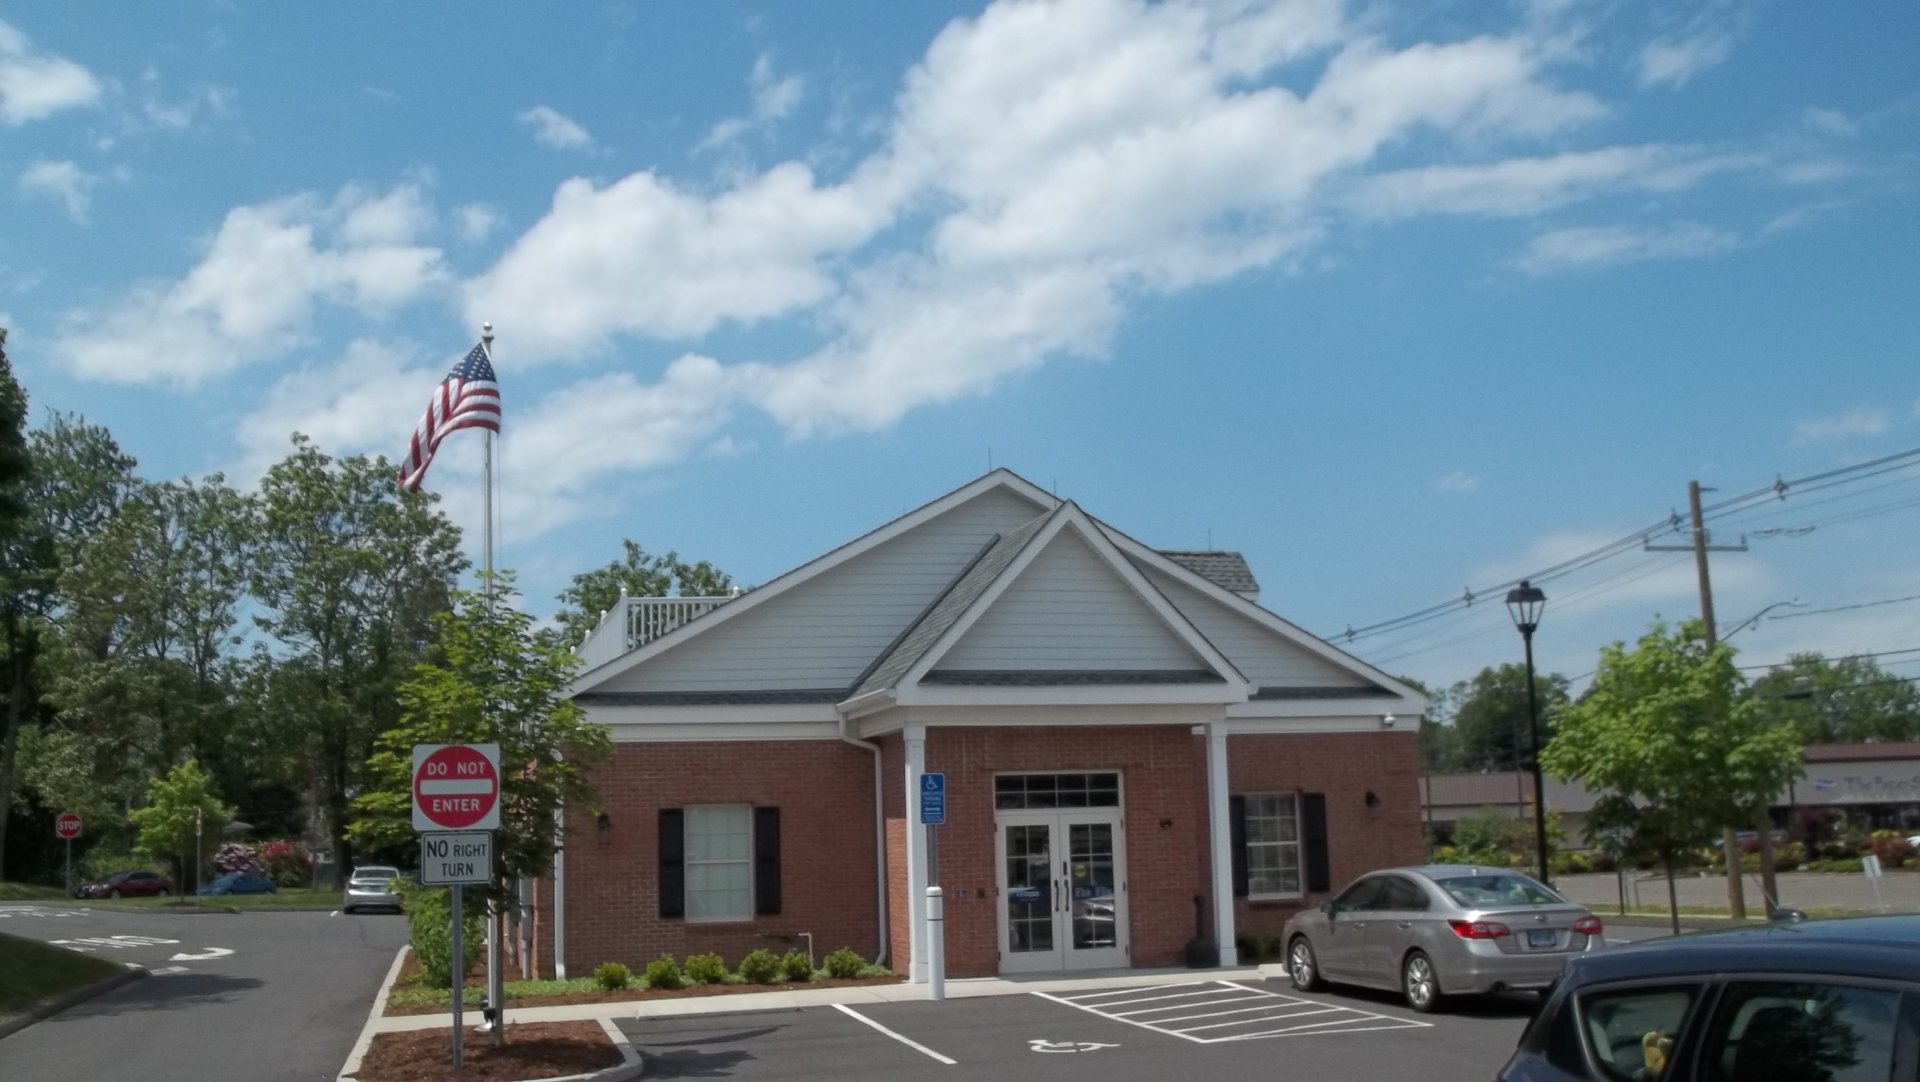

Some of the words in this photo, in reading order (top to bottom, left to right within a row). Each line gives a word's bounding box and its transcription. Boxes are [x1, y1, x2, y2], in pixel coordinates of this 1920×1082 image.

[427, 762, 447, 776] DO
[457, 761, 486, 775] NOT
[432, 798, 480, 812] ENTER
[58, 820, 81, 831] STOP
[426, 840, 448, 858] NO
[453, 843, 487, 857] RIGHT
[441, 862, 474, 876] TURN
